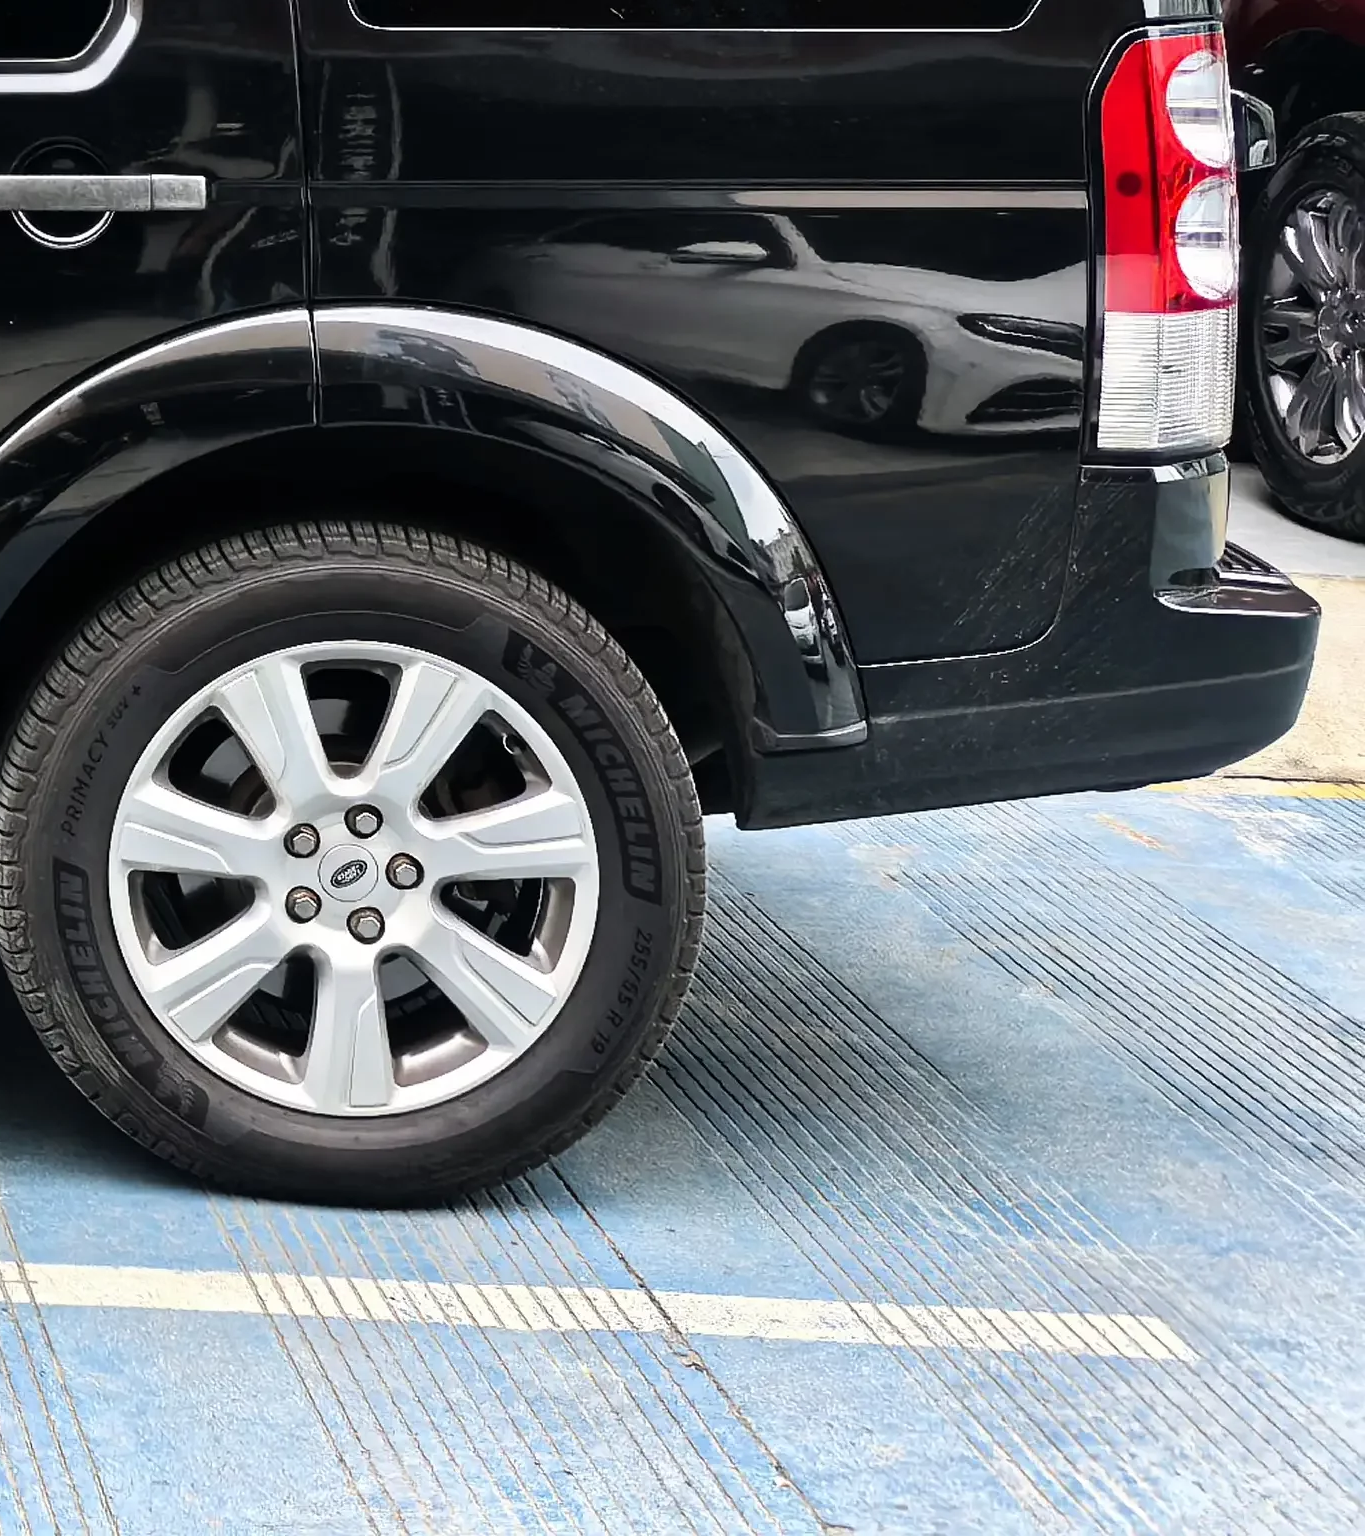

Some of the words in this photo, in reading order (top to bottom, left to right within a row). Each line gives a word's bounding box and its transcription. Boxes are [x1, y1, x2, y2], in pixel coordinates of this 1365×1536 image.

[61, 731, 109, 837] PRIMACY
[558, 693, 657, 893] MICHELIN
[58, 869, 157, 1069] MICHELIN
